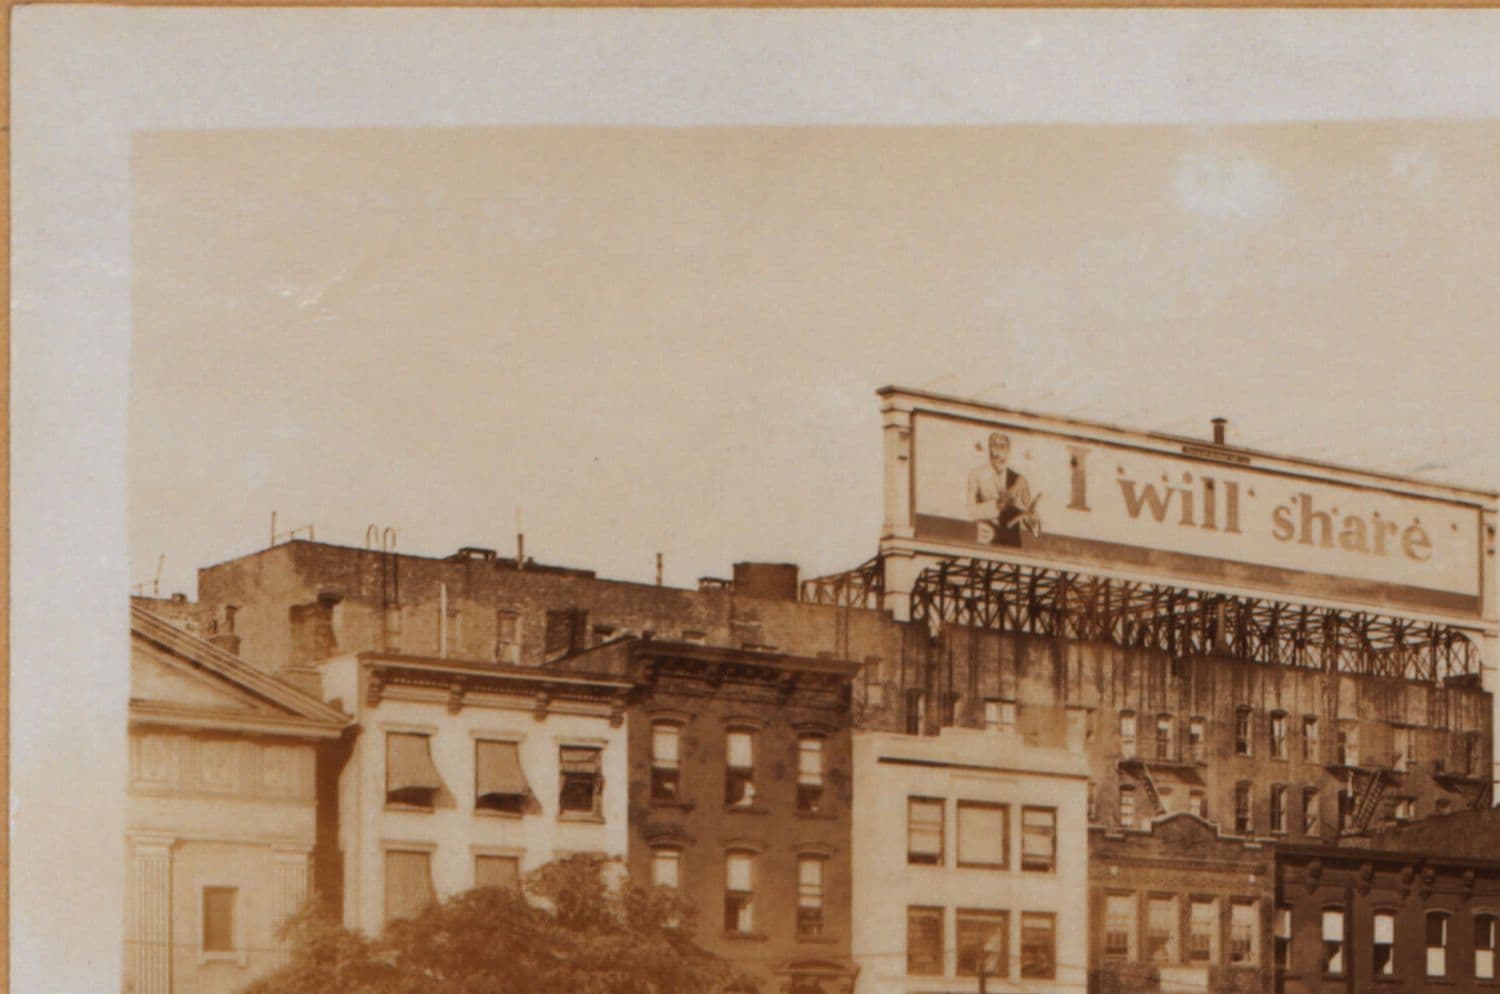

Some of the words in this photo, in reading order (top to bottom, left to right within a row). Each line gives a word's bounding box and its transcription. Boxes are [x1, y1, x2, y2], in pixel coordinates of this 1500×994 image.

[1065, 446, 1092, 513] I
[1118, 472, 1243, 535] will
[1272, 493, 1434, 563] share
